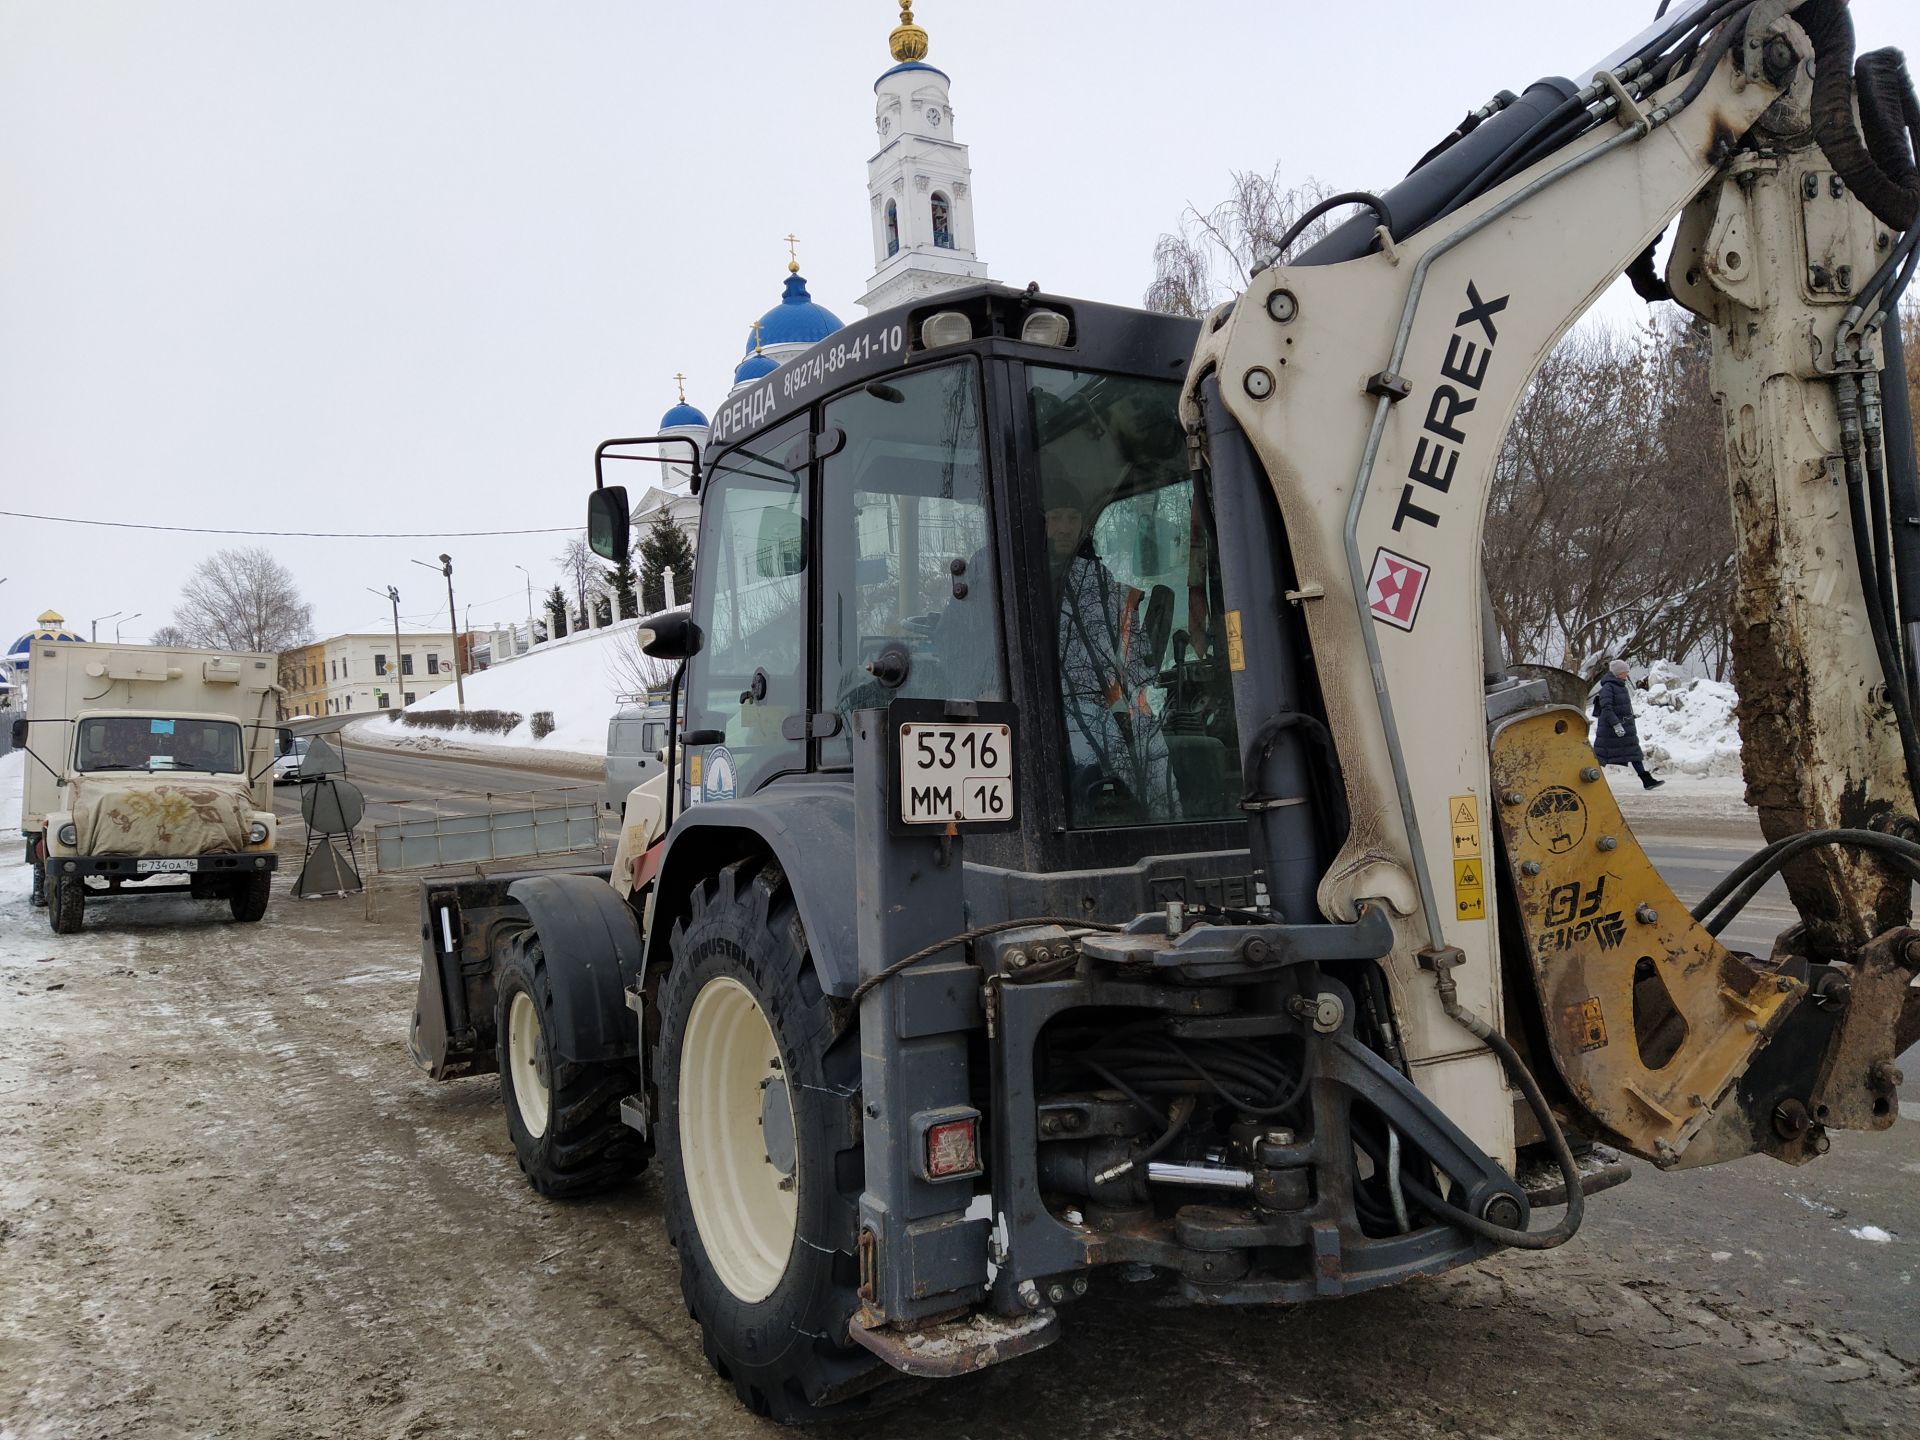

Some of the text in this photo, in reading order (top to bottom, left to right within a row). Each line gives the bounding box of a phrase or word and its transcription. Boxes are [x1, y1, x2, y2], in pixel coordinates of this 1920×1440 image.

[712, 382, 776, 445] АРЕНДА
[1391, 278, 1510, 533] TEREX
[917, 731, 998, 769] 5316
[974, 785, 1004, 814] 16
